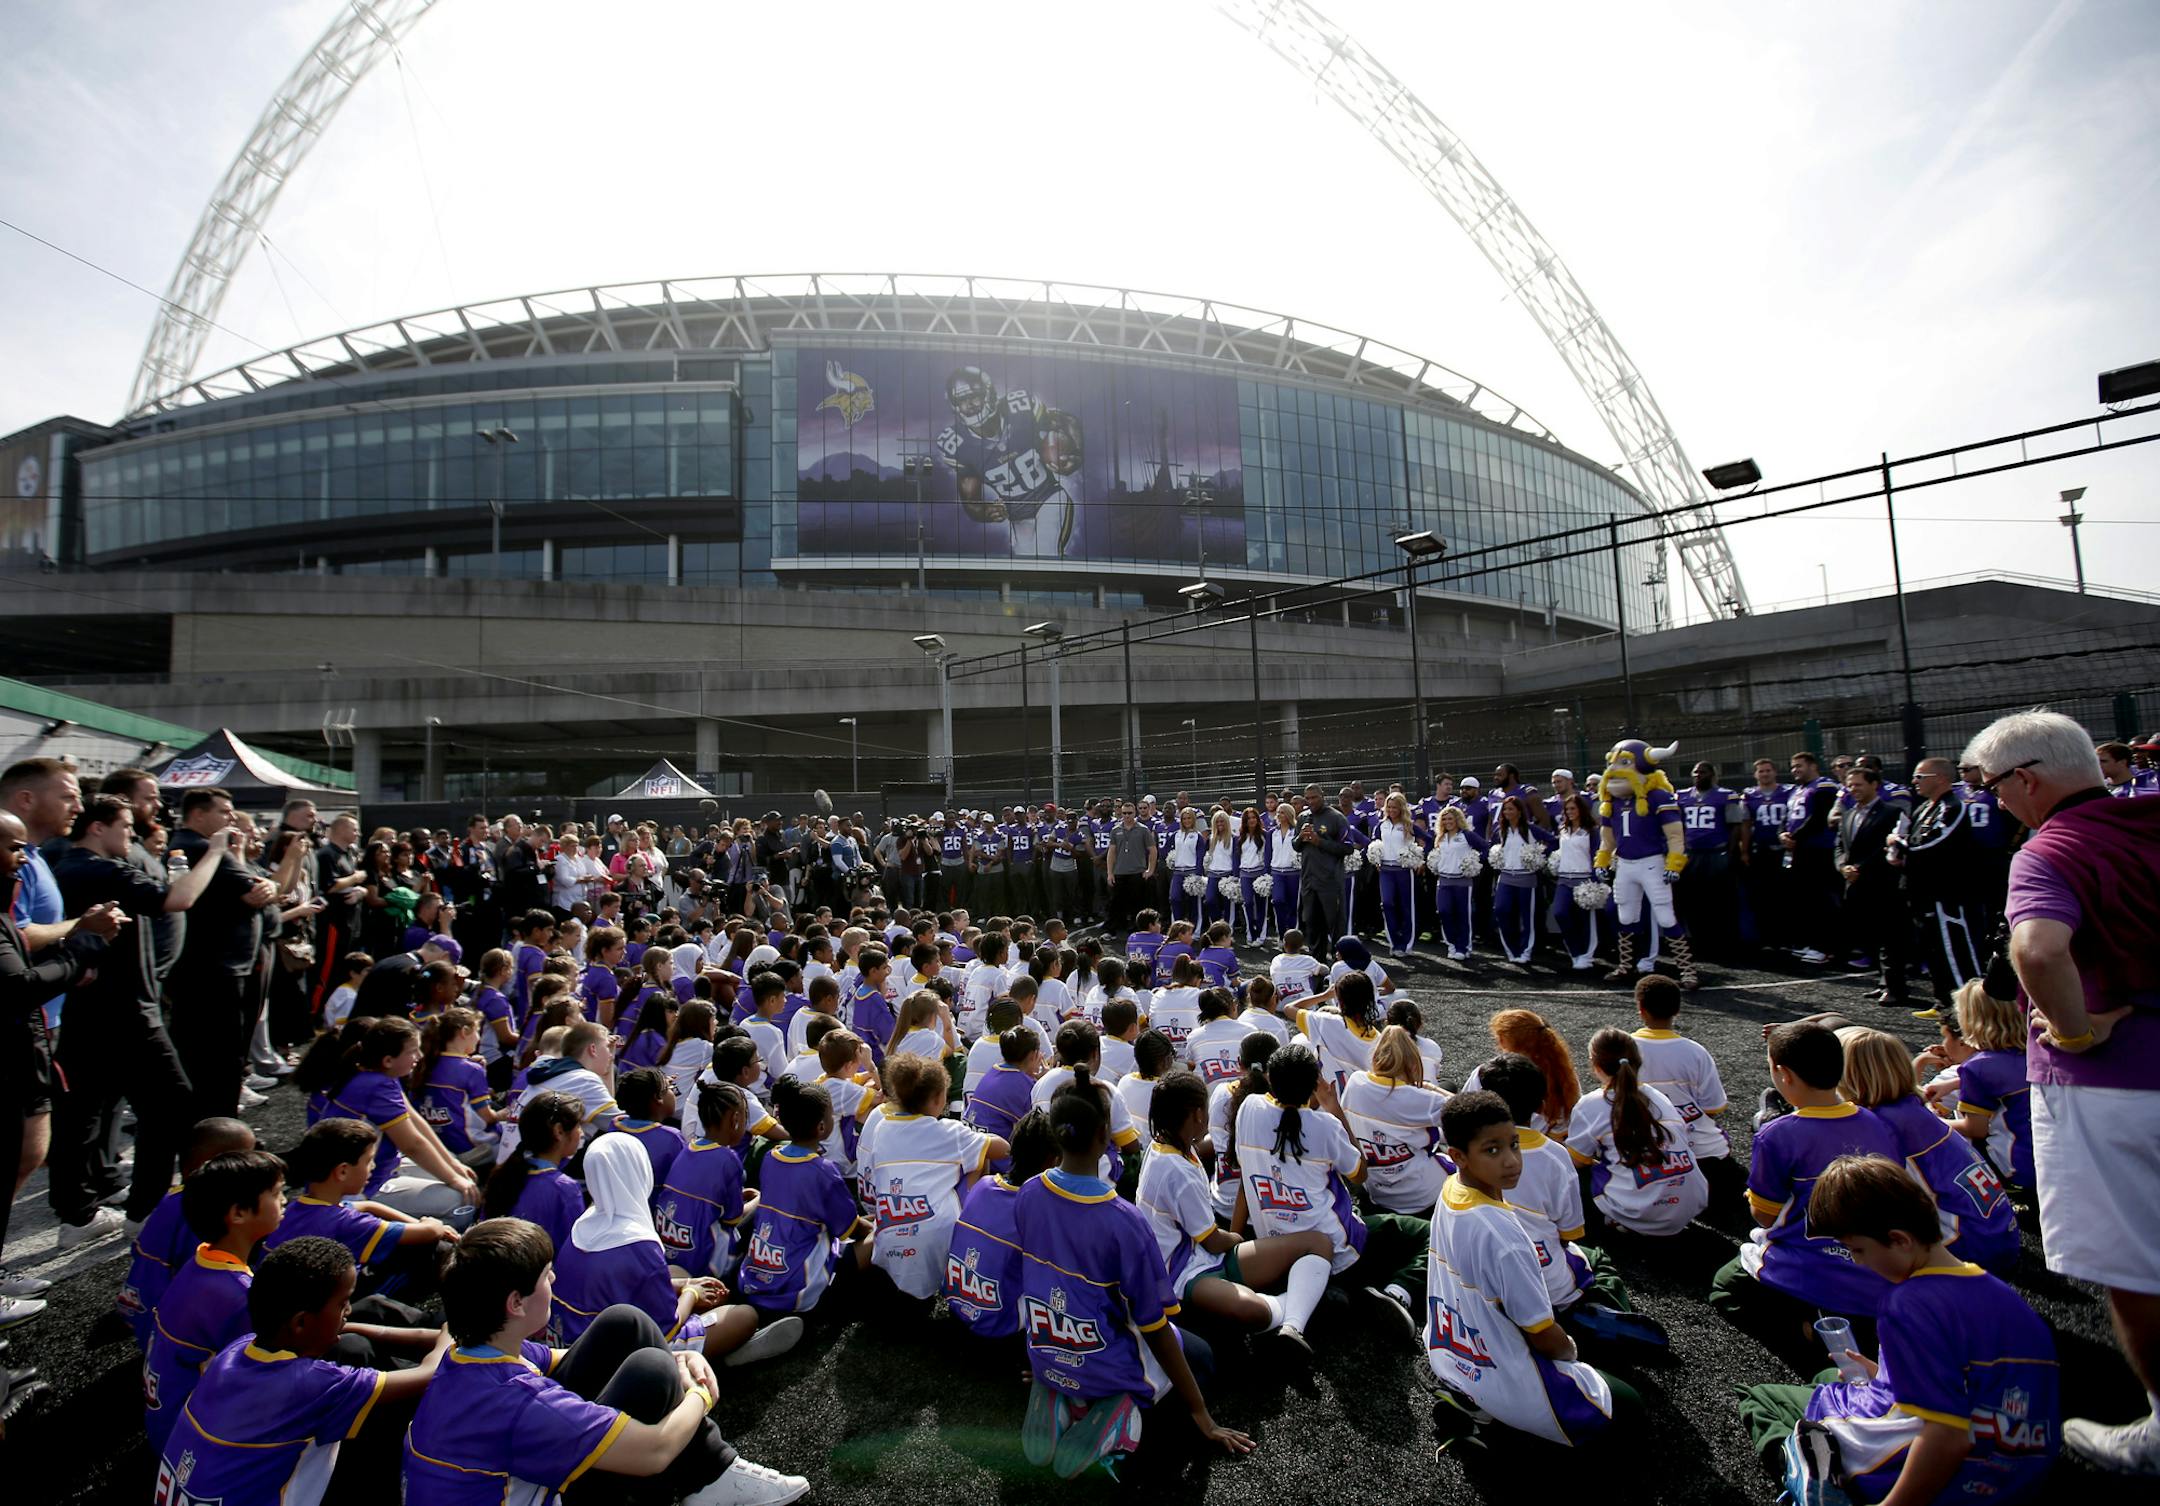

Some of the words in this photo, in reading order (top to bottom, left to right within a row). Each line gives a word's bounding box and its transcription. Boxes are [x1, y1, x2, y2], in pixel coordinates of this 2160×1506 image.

[985, 448, 1047, 497] 28
[163, 771, 210, 784] NFL
[650, 786, 676, 795] NFL
[1491, 802, 1502, 825] 7
[1621, 811, 1631, 837] 1
[1684, 805, 1716, 829] 92
[1756, 803, 1786, 826] 40
[1969, 803, 1989, 827] 0
[944, 836, 962, 851] 26
[1012, 836, 1029, 850] 29
[1279, 984, 1303, 995] FLAG
[1205, 1060, 1240, 1075] FLA
[1360, 1140, 1409, 1160] FLAG
[1255, 1178, 1307, 1205] FLAG
[1966, 1165, 1999, 1197] FL
[877, 1196, 929, 1221] FLAG
[656, 1208, 691, 1245] FLAG
[750, 1236, 783, 1267] FLAG
[947, 1258, 997, 1302] FLAG
[1029, 1301, 1099, 1343] FLAG
[1969, 1407, 2046, 1447] FLAG
